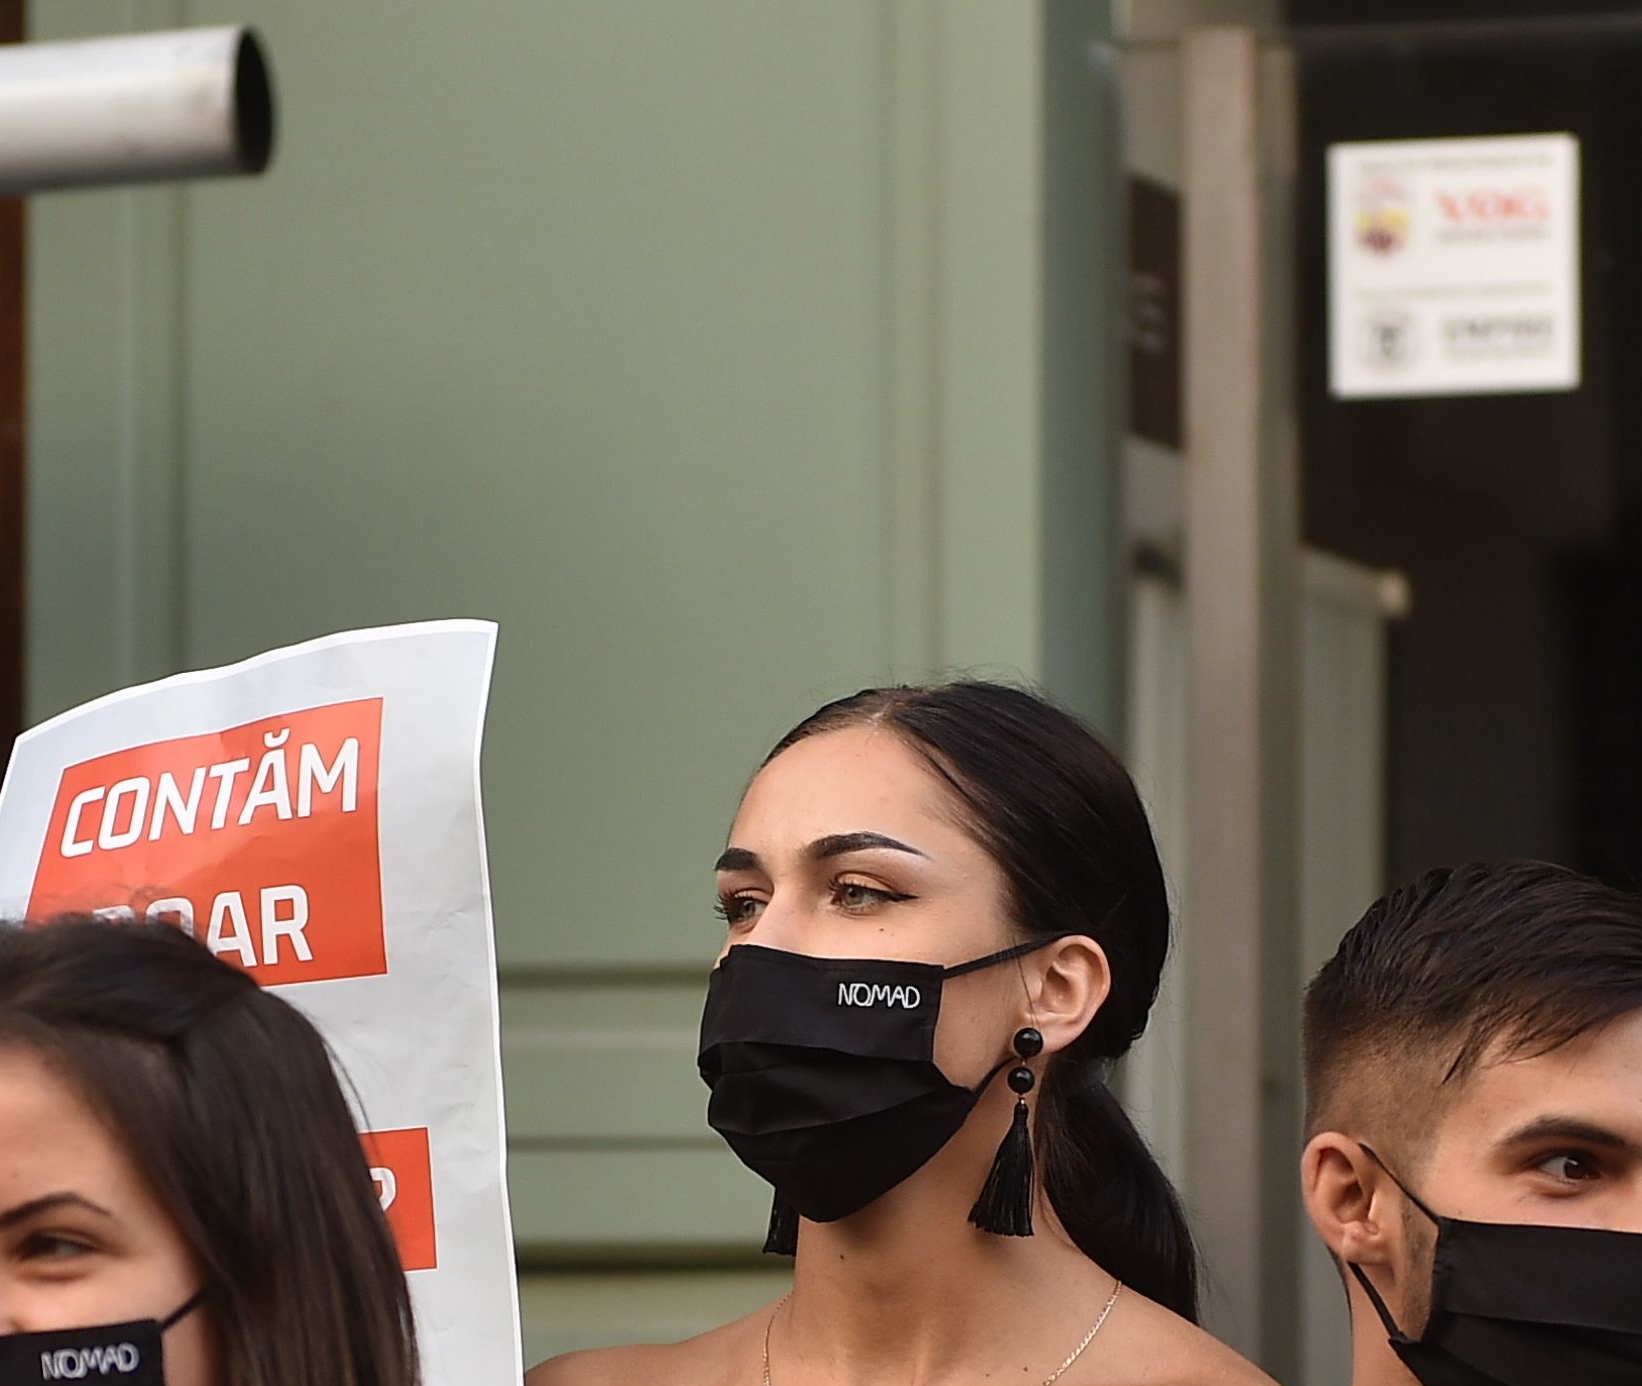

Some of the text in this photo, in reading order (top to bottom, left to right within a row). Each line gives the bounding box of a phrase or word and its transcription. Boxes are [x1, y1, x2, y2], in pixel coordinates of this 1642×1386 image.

[60, 728, 359, 858] CONTĂM
[92, 884, 313, 967] AR
[838, 983, 920, 1008] NOMAD
[41, 1342, 139, 1380] NOMAD
